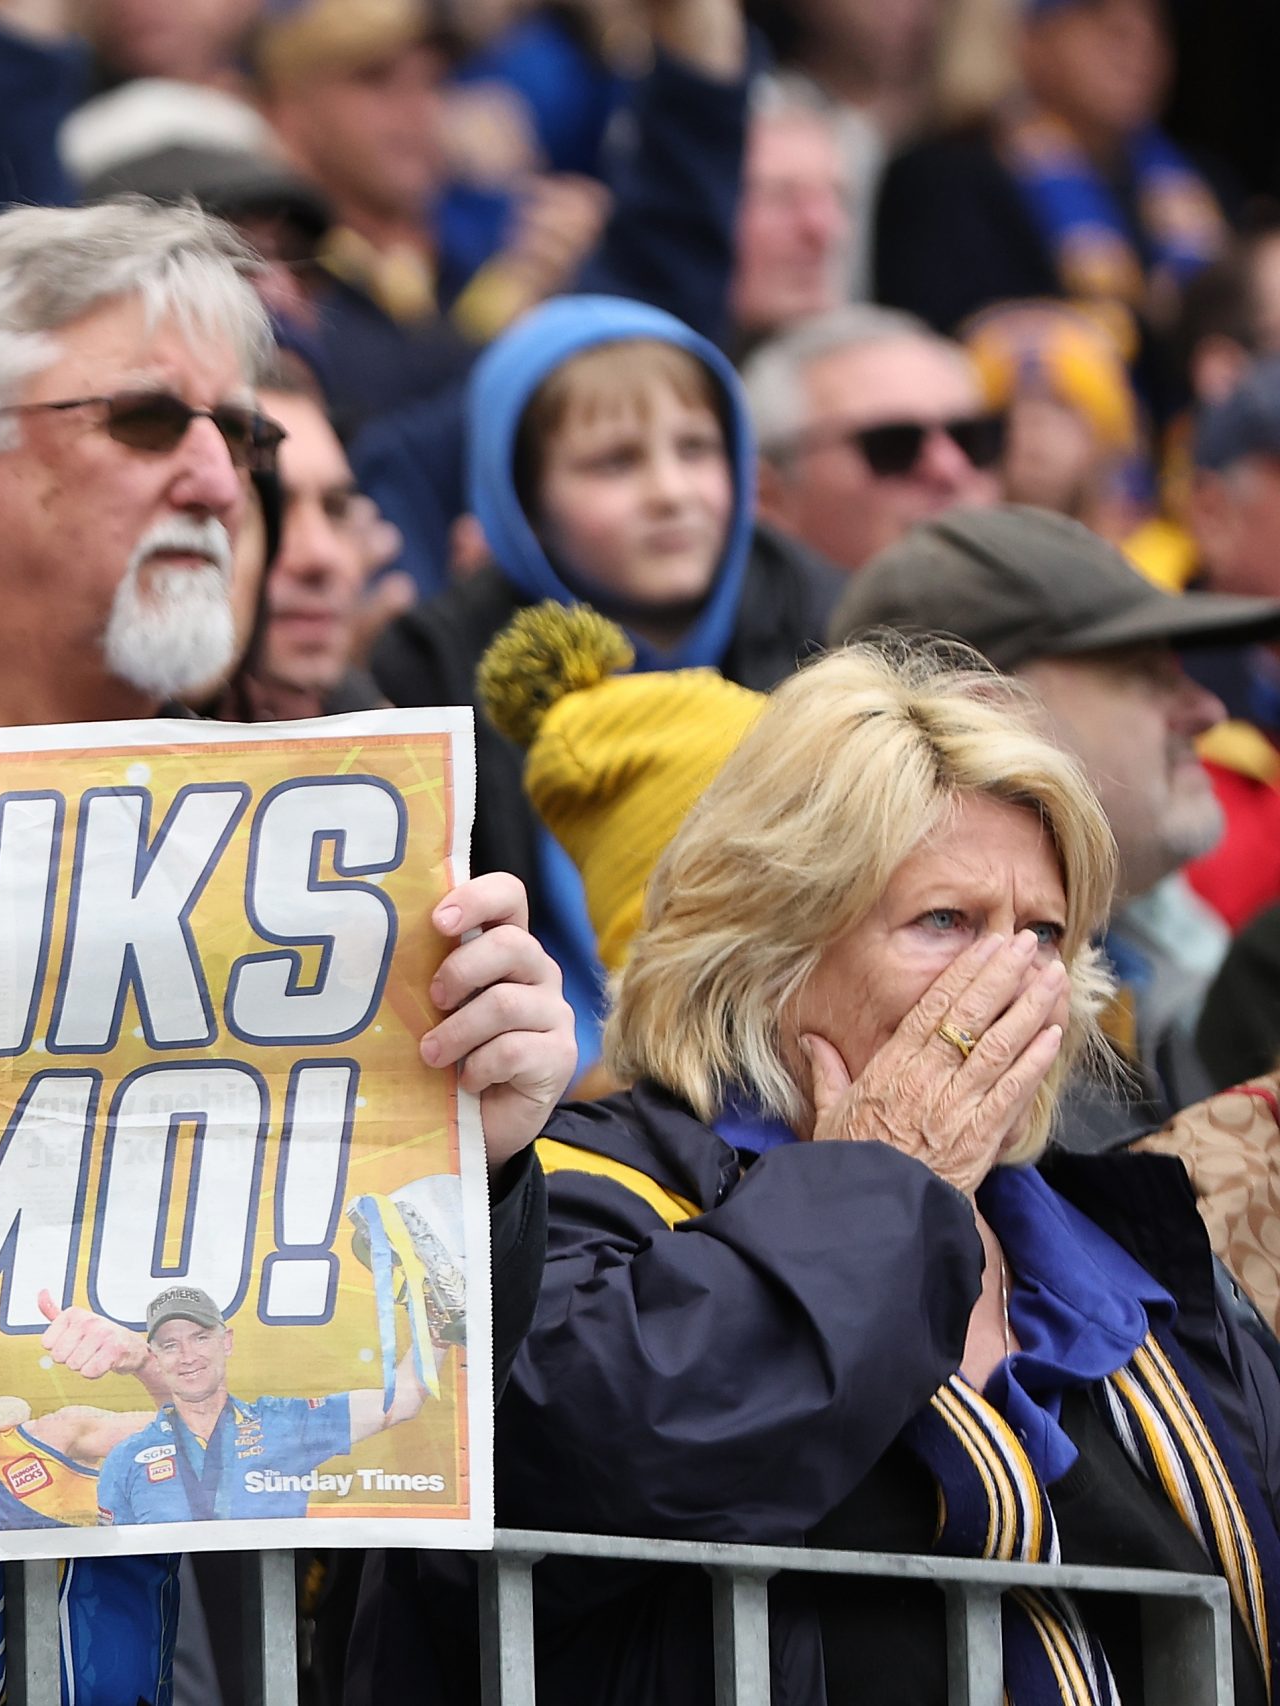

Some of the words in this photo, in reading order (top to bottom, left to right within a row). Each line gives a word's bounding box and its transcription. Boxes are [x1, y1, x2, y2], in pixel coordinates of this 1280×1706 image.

[10, 1462, 39, 1480] HUNGRY
[14, 1468, 44, 1488] JACK'S
[264, 1468, 282, 1477] The
[356, 1468, 445, 1492] Times
[244, 1470, 354, 1496] Sunday
